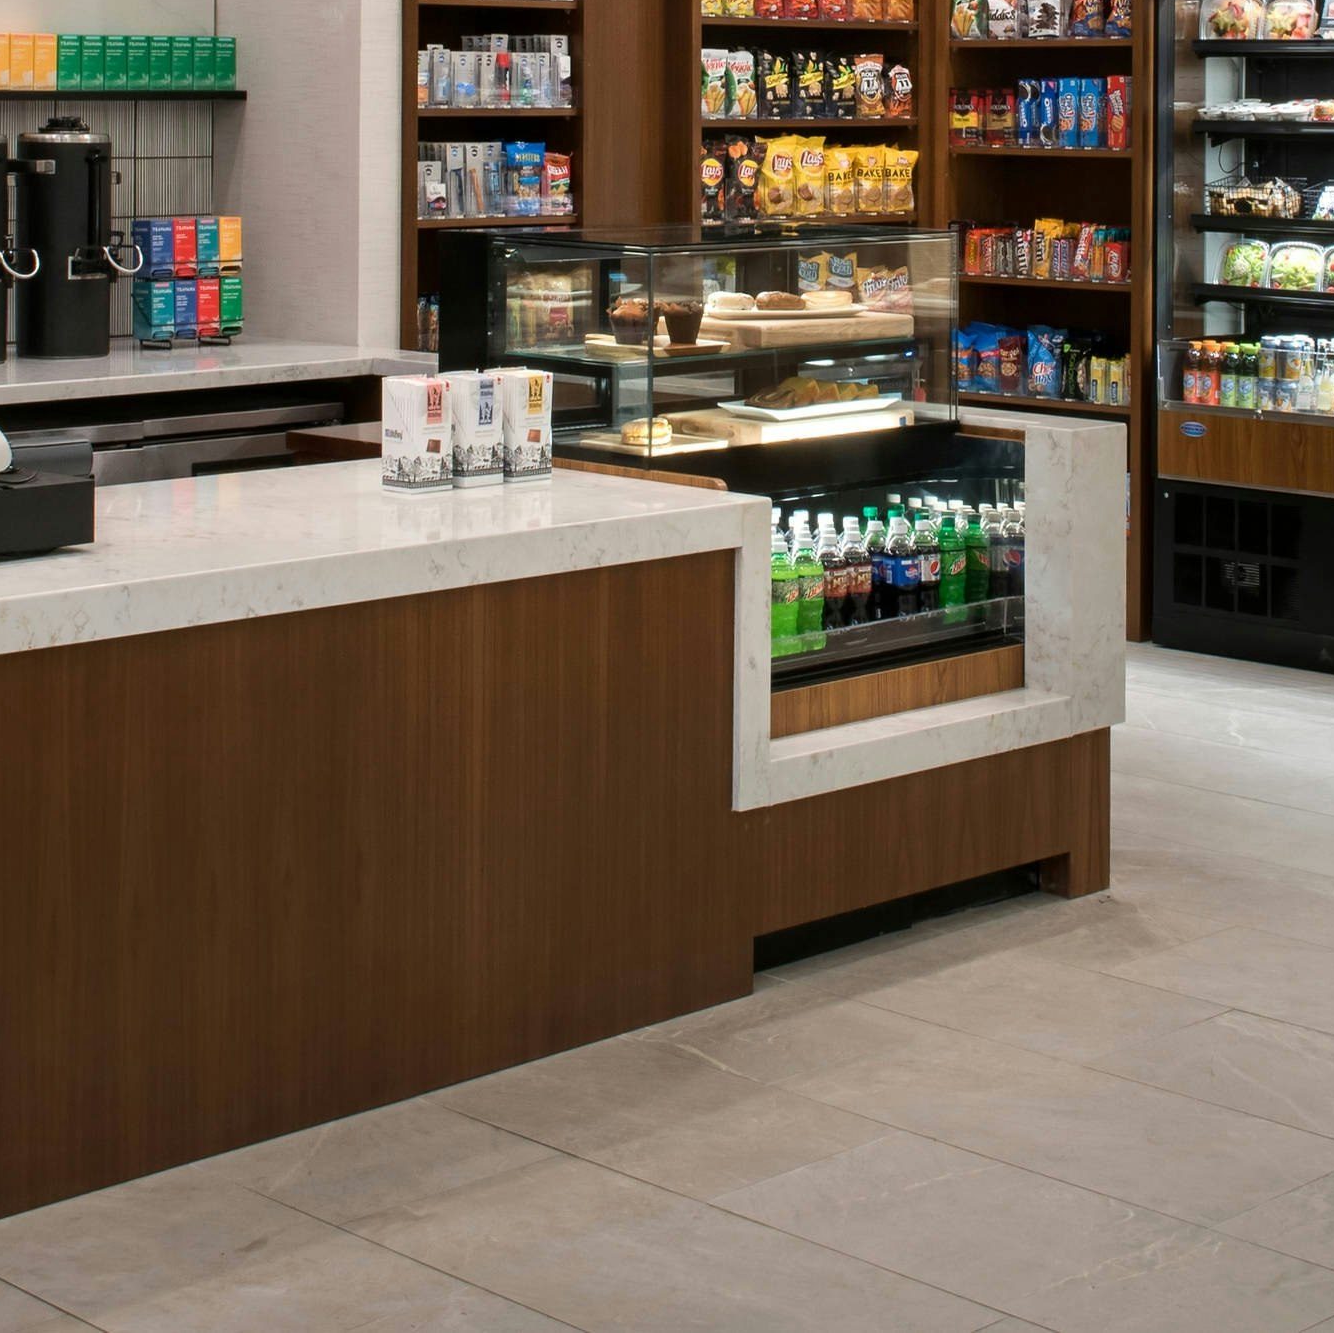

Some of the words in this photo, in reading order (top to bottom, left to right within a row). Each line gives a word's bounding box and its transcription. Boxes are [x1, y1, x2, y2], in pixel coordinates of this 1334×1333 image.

[803, 151, 824, 166] Lay's
[702, 165, 722, 178] Lay's
[828, 167, 853, 181] BAKE
[857, 168, 883, 178] BAKE
[885, 168, 910, 178] BAKE
